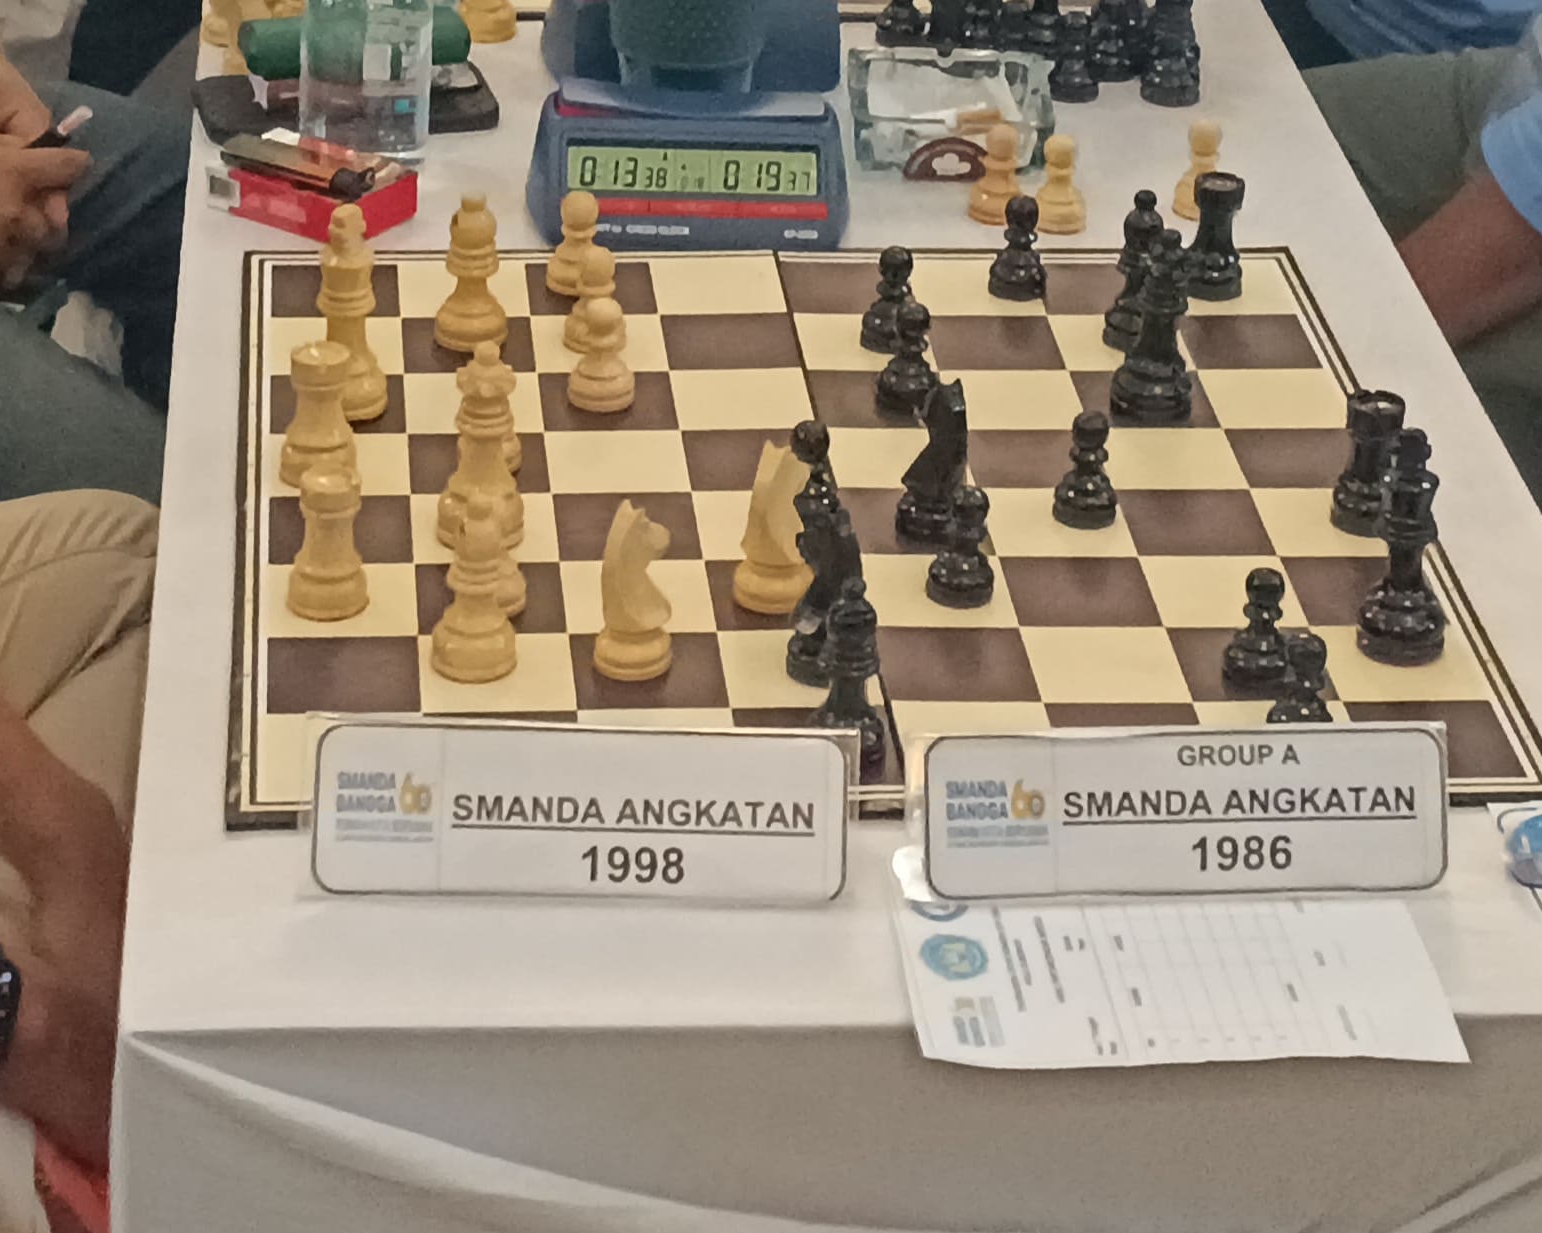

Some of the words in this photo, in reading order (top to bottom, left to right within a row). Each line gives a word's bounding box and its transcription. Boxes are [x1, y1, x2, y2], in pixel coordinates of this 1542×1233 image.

[1176, 744, 1274, 767] GROUP
[1281, 744, 1301, 766] A
[452, 794, 606, 825] SMANDA
[615, 799, 816, 830] ANGKATAN
[1062, 789, 1213, 819] SMANDA
[1222, 785, 1417, 816] ANGKATAN
[580, 844, 686, 885] 1998
[1191, 834, 1293, 872] 1986
